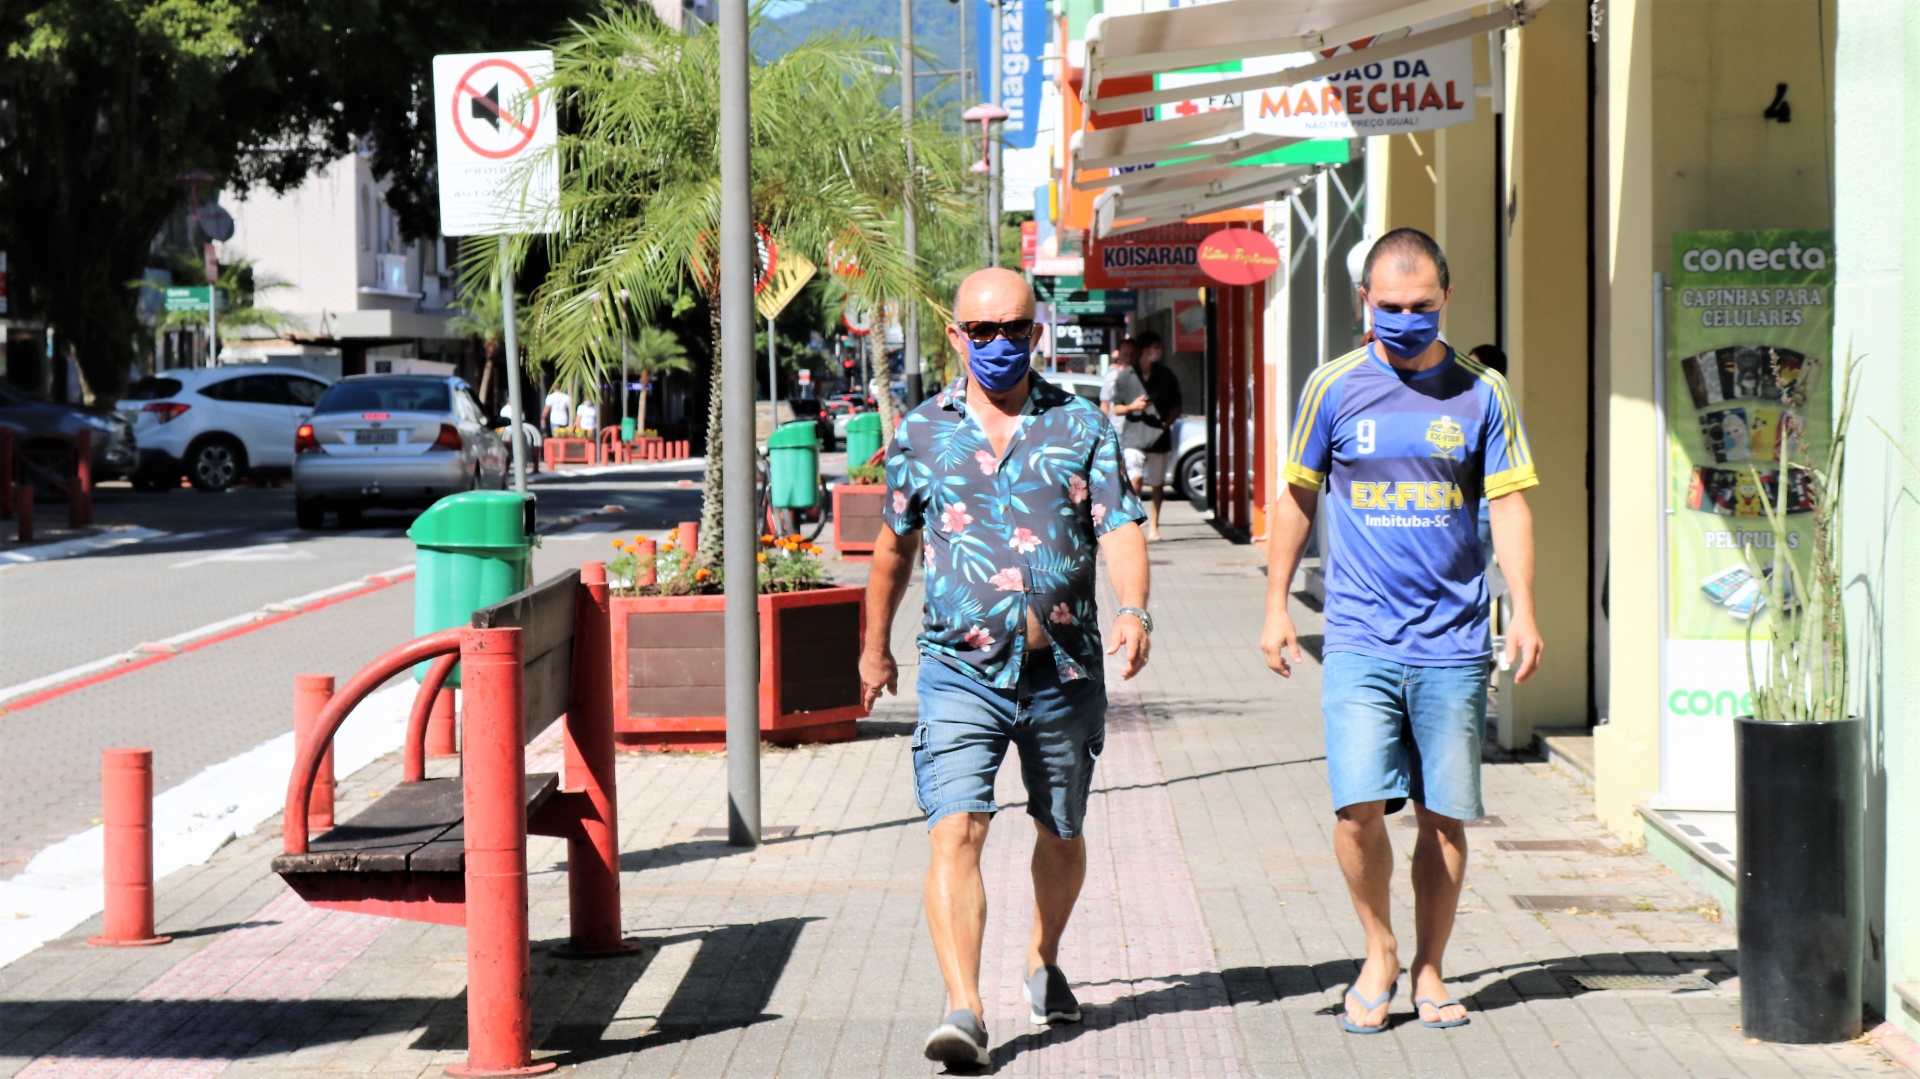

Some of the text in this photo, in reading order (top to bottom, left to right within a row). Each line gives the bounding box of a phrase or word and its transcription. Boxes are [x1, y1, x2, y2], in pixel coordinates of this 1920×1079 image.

[1393, 59, 1430, 78] DA
[1259, 80, 1465, 118] MARECHAL
[1764, 82, 1791, 123] 4
[1305, 116, 1419, 129] NÃO TEM PREÇO IGUAL!
[1103, 245, 1199, 269] KOISARAD
[1682, 240, 1826, 272] conecta
[1682, 286, 1823, 307] CAPINHAS PARA
[1702, 308, 1803, 327] CELULARES
[1356, 419, 1376, 454] 9
[1430, 433, 1461, 443] EX-FISH
[1351, 480, 1464, 511] EX-FISH
[1365, 514, 1450, 528] Imbituba-SC
[1704, 526, 1799, 550] PELÍCULS
